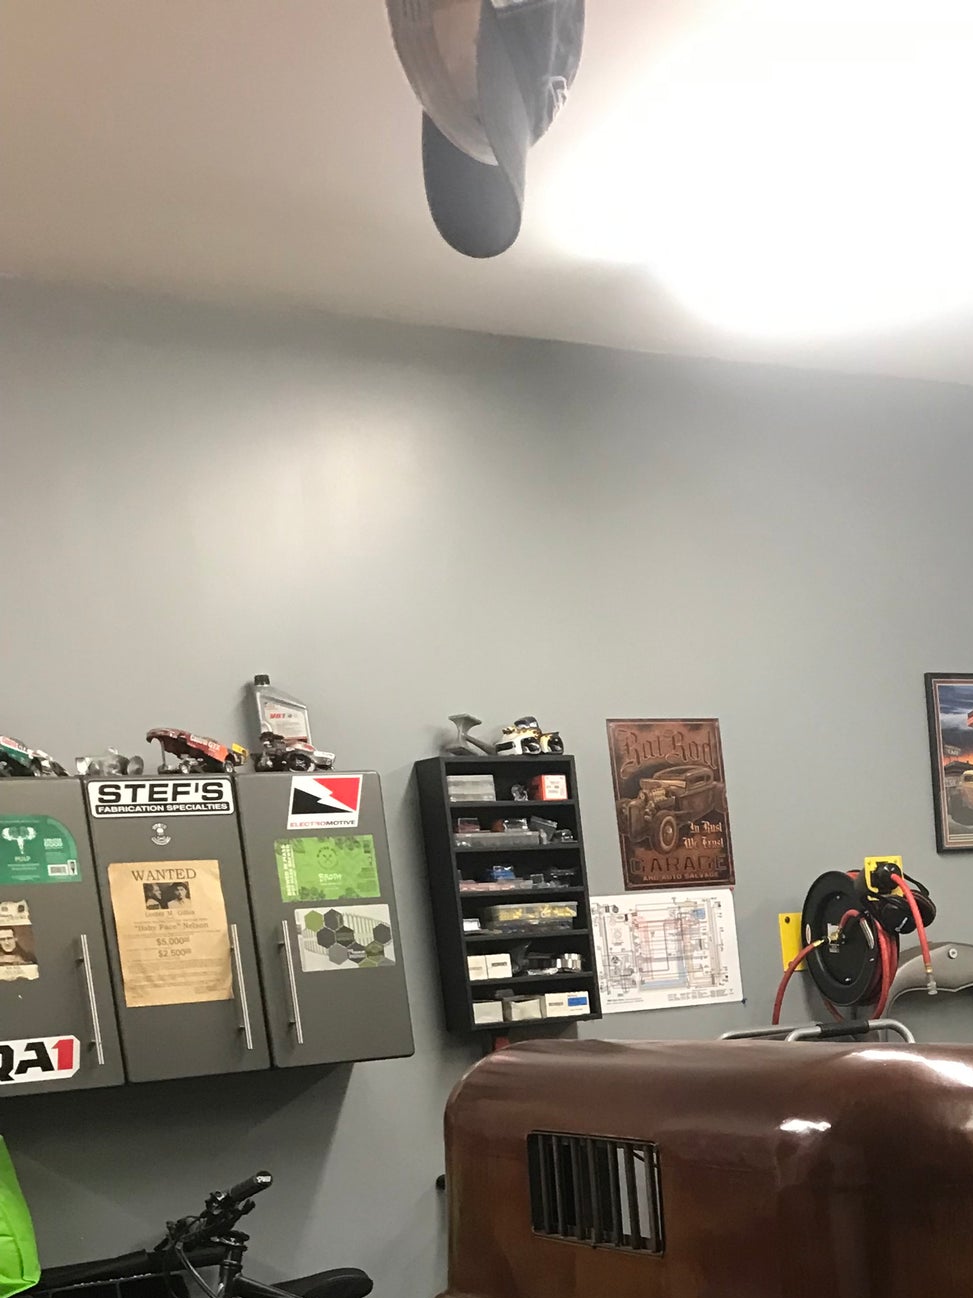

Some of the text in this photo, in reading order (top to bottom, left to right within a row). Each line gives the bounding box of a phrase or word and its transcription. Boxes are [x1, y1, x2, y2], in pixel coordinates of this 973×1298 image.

[616, 728, 717, 779] Rat Rod
[98, 782, 223, 804] STEF'S
[98, 802, 228, 814] FABRICATION SPECIALTIES
[290, 820, 356, 828] ELECTROMOTIVE
[629, 854, 727, 874] GARAGE
[131, 868, 197, 881] WANTED
